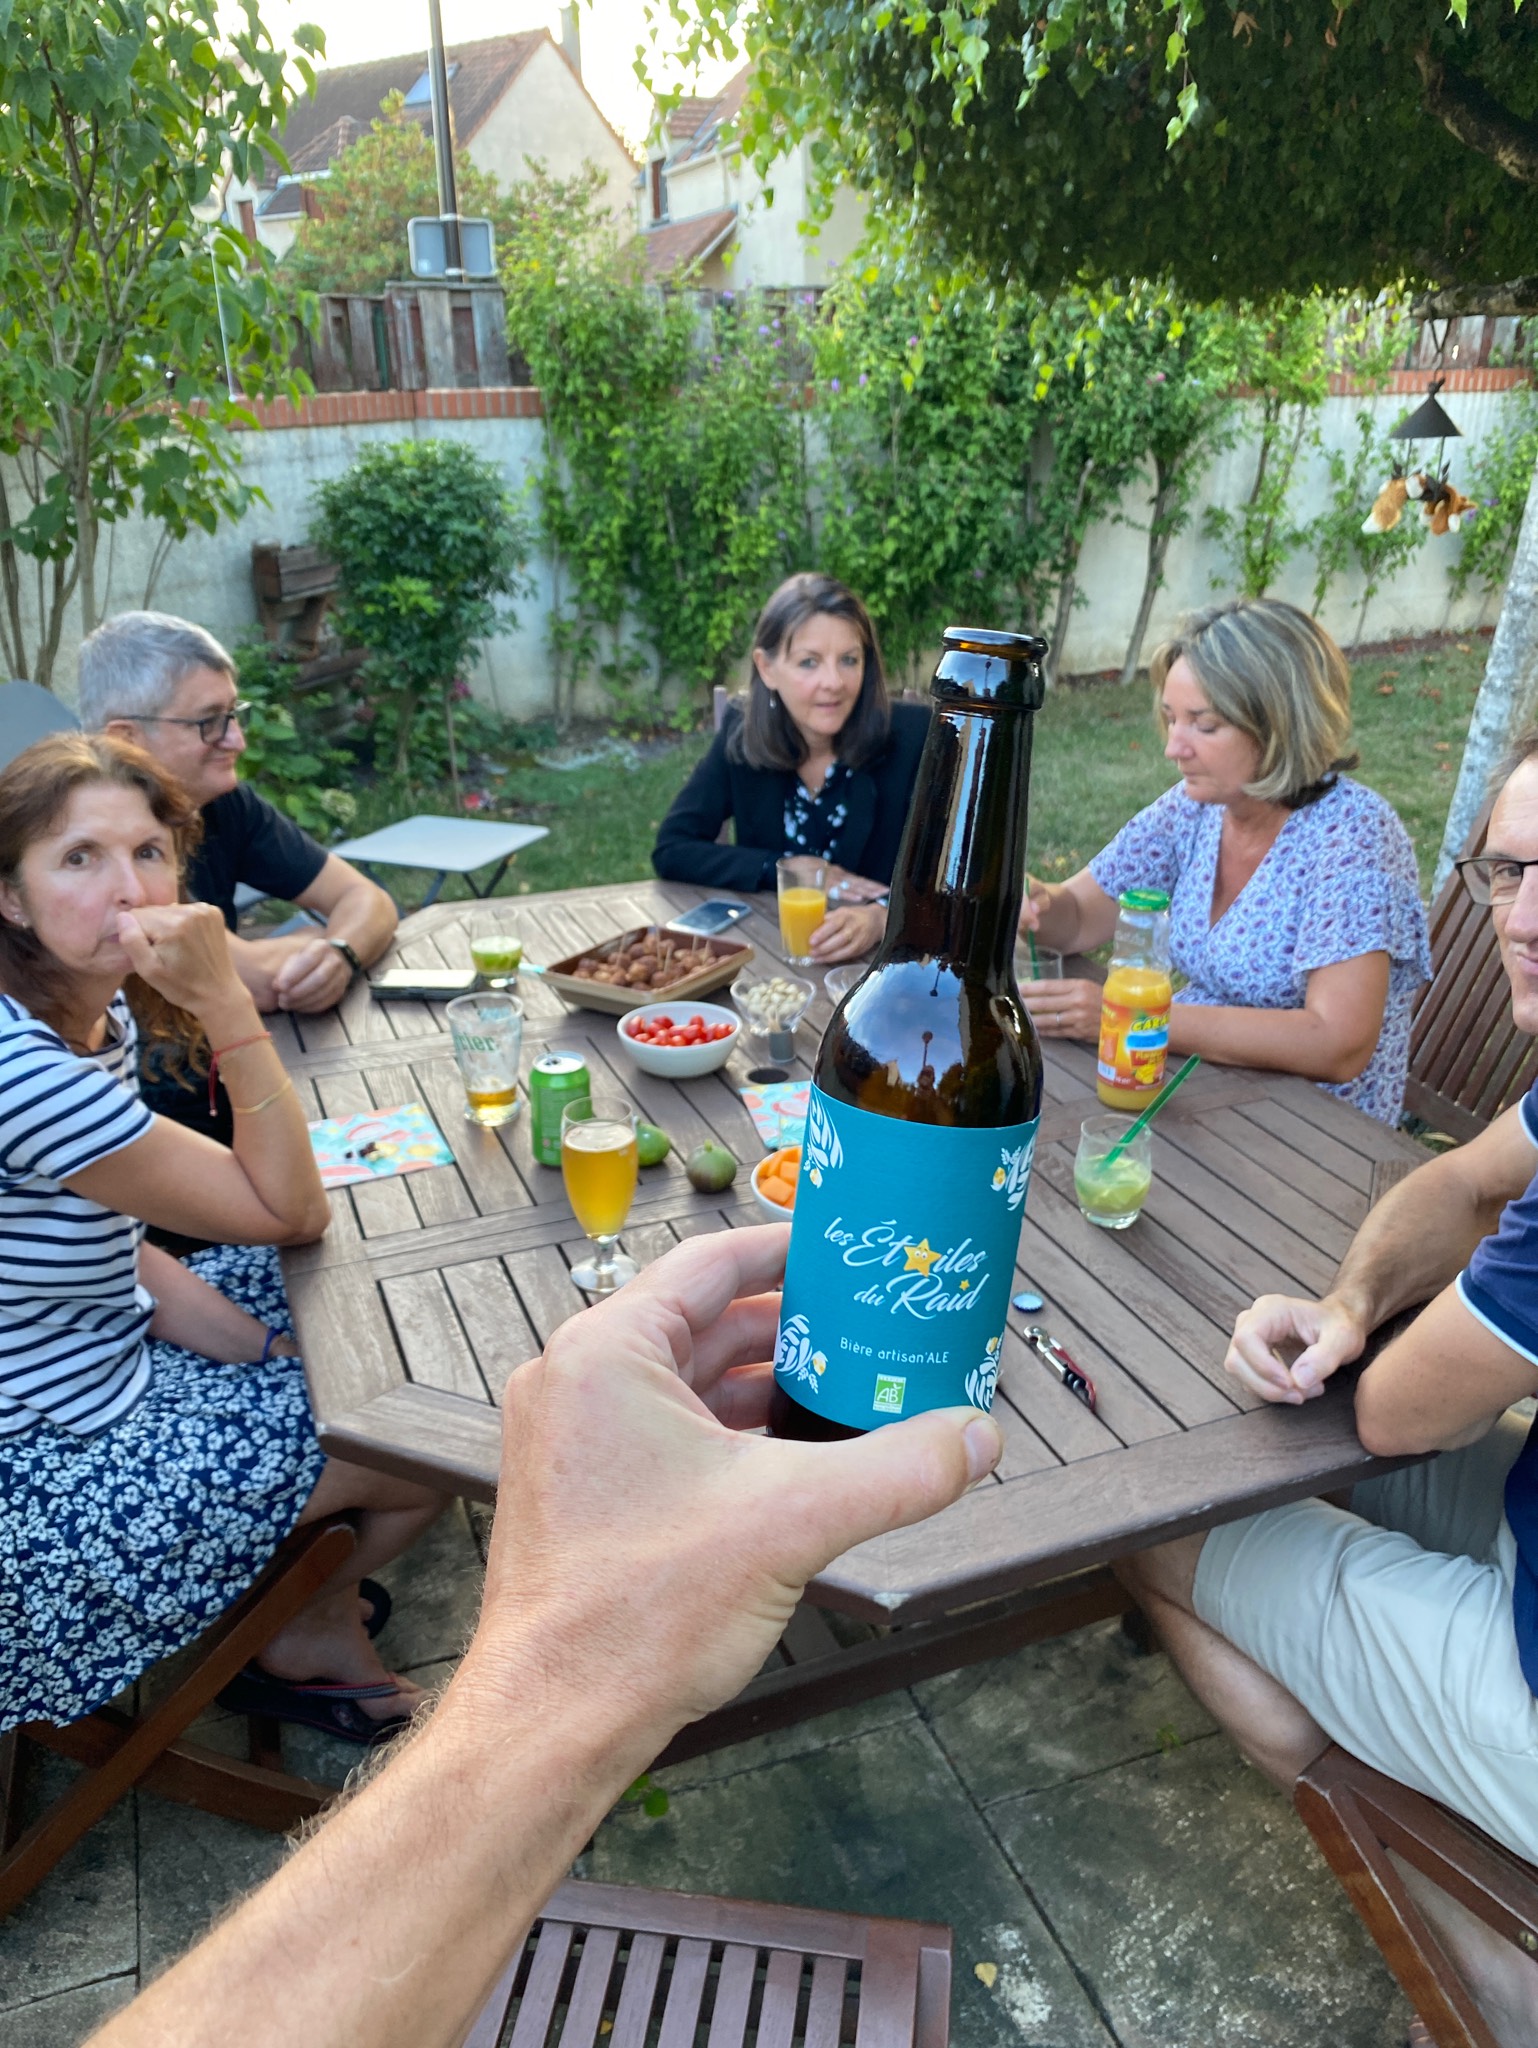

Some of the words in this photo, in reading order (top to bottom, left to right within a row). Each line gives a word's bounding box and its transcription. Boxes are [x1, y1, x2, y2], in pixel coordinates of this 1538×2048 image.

[824, 1216, 855, 1246] les
[842, 1219, 988, 1274] Étiles
[853, 1284, 886, 1306] du
[885, 1273, 990, 1320] Raid
[840, 1336, 872, 1357] Bière
[877, 1349, 949, 1364] artisan'ALE
[876, 1387, 899, 1403] AB
